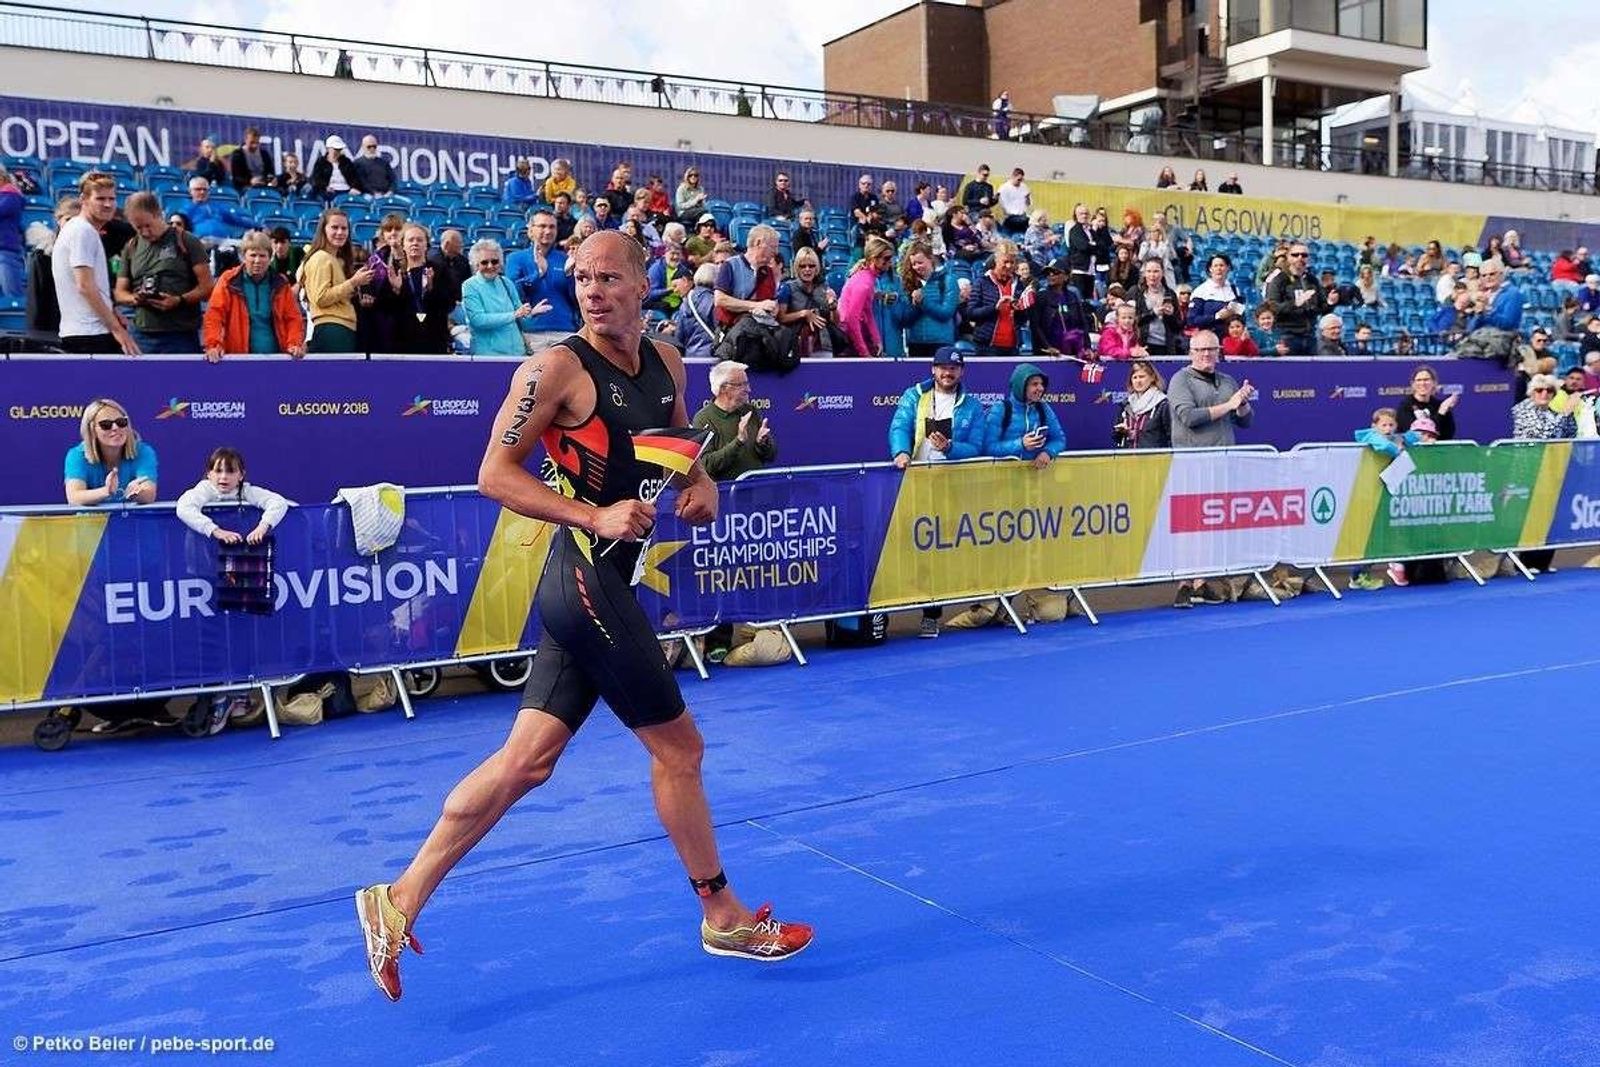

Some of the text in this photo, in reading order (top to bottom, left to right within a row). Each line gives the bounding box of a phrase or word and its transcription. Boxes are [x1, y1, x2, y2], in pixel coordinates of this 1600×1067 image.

[1165, 204, 1322, 239] GLASGOW 2018
[9, 405, 83, 419] GLASGOW
[191, 402, 246, 412] EUROPEAN
[278, 402, 370, 415] GLASGOW 2018
[432, 399, 479, 410] EUROPEAN
[501, 380, 537, 447] 1375
[1392, 472, 1486, 496] TRATHCLYDE
[1201, 494, 1304, 526] SPAR
[1389, 491, 1454, 518] COUNTRY
[1455, 492, 1494, 514] PARK
[691, 505, 837, 546] EUROPEAN
[913, 502, 1131, 551] GLASGOW 2018
[692, 536, 838, 568] CHAMPIONSHIPS
[694, 559, 819, 595] TRIATHLON
